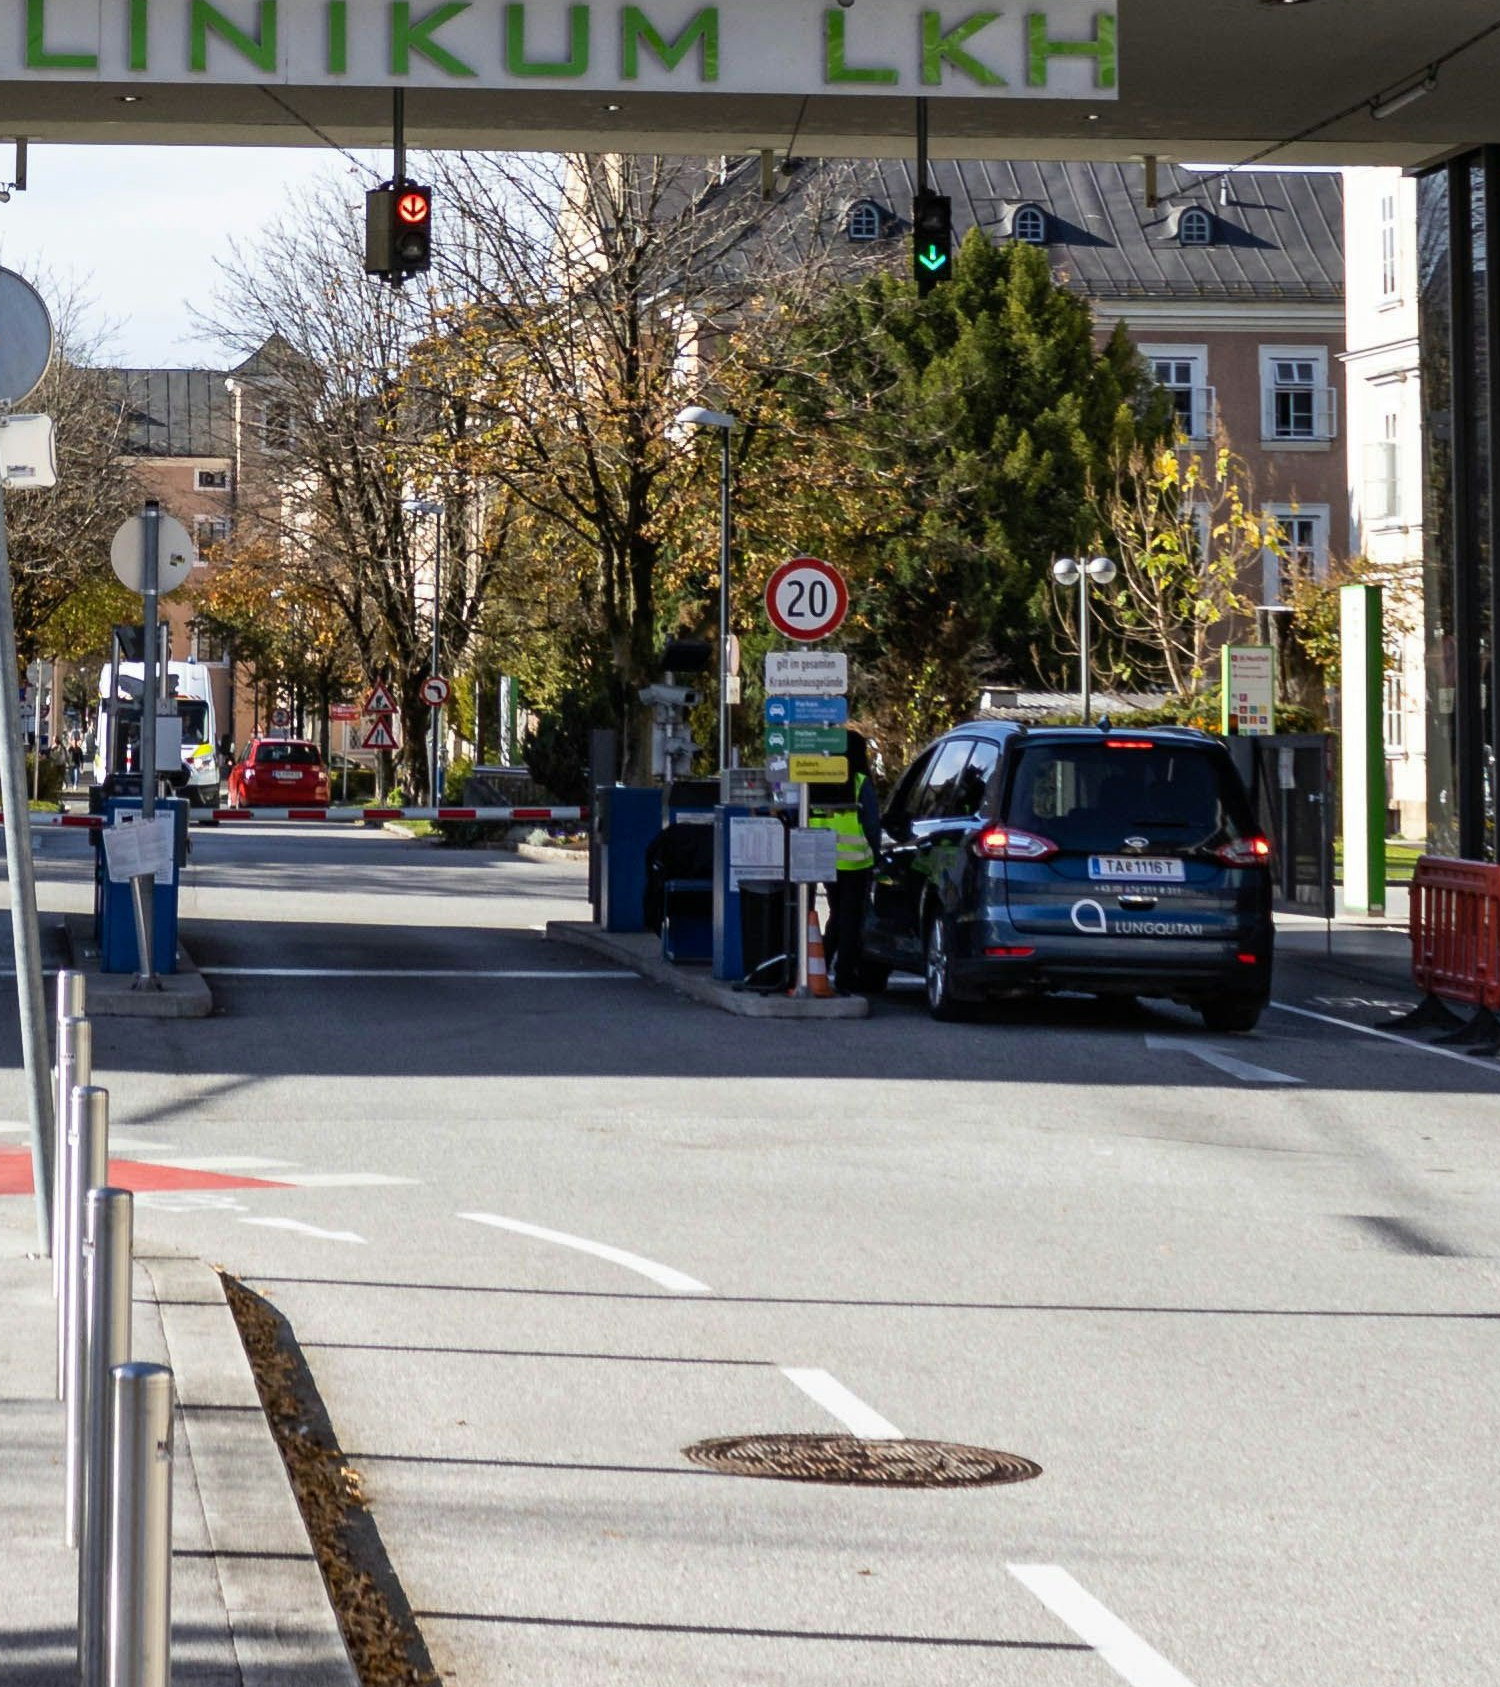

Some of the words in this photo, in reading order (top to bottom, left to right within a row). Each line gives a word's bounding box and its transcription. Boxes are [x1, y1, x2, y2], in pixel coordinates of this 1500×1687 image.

[824, 7, 1117, 89] LKH
[787, 579, 828, 618] 20
[801, 660, 836, 672] gesamten
[768, 676, 844, 690] Krankenhausgelände
